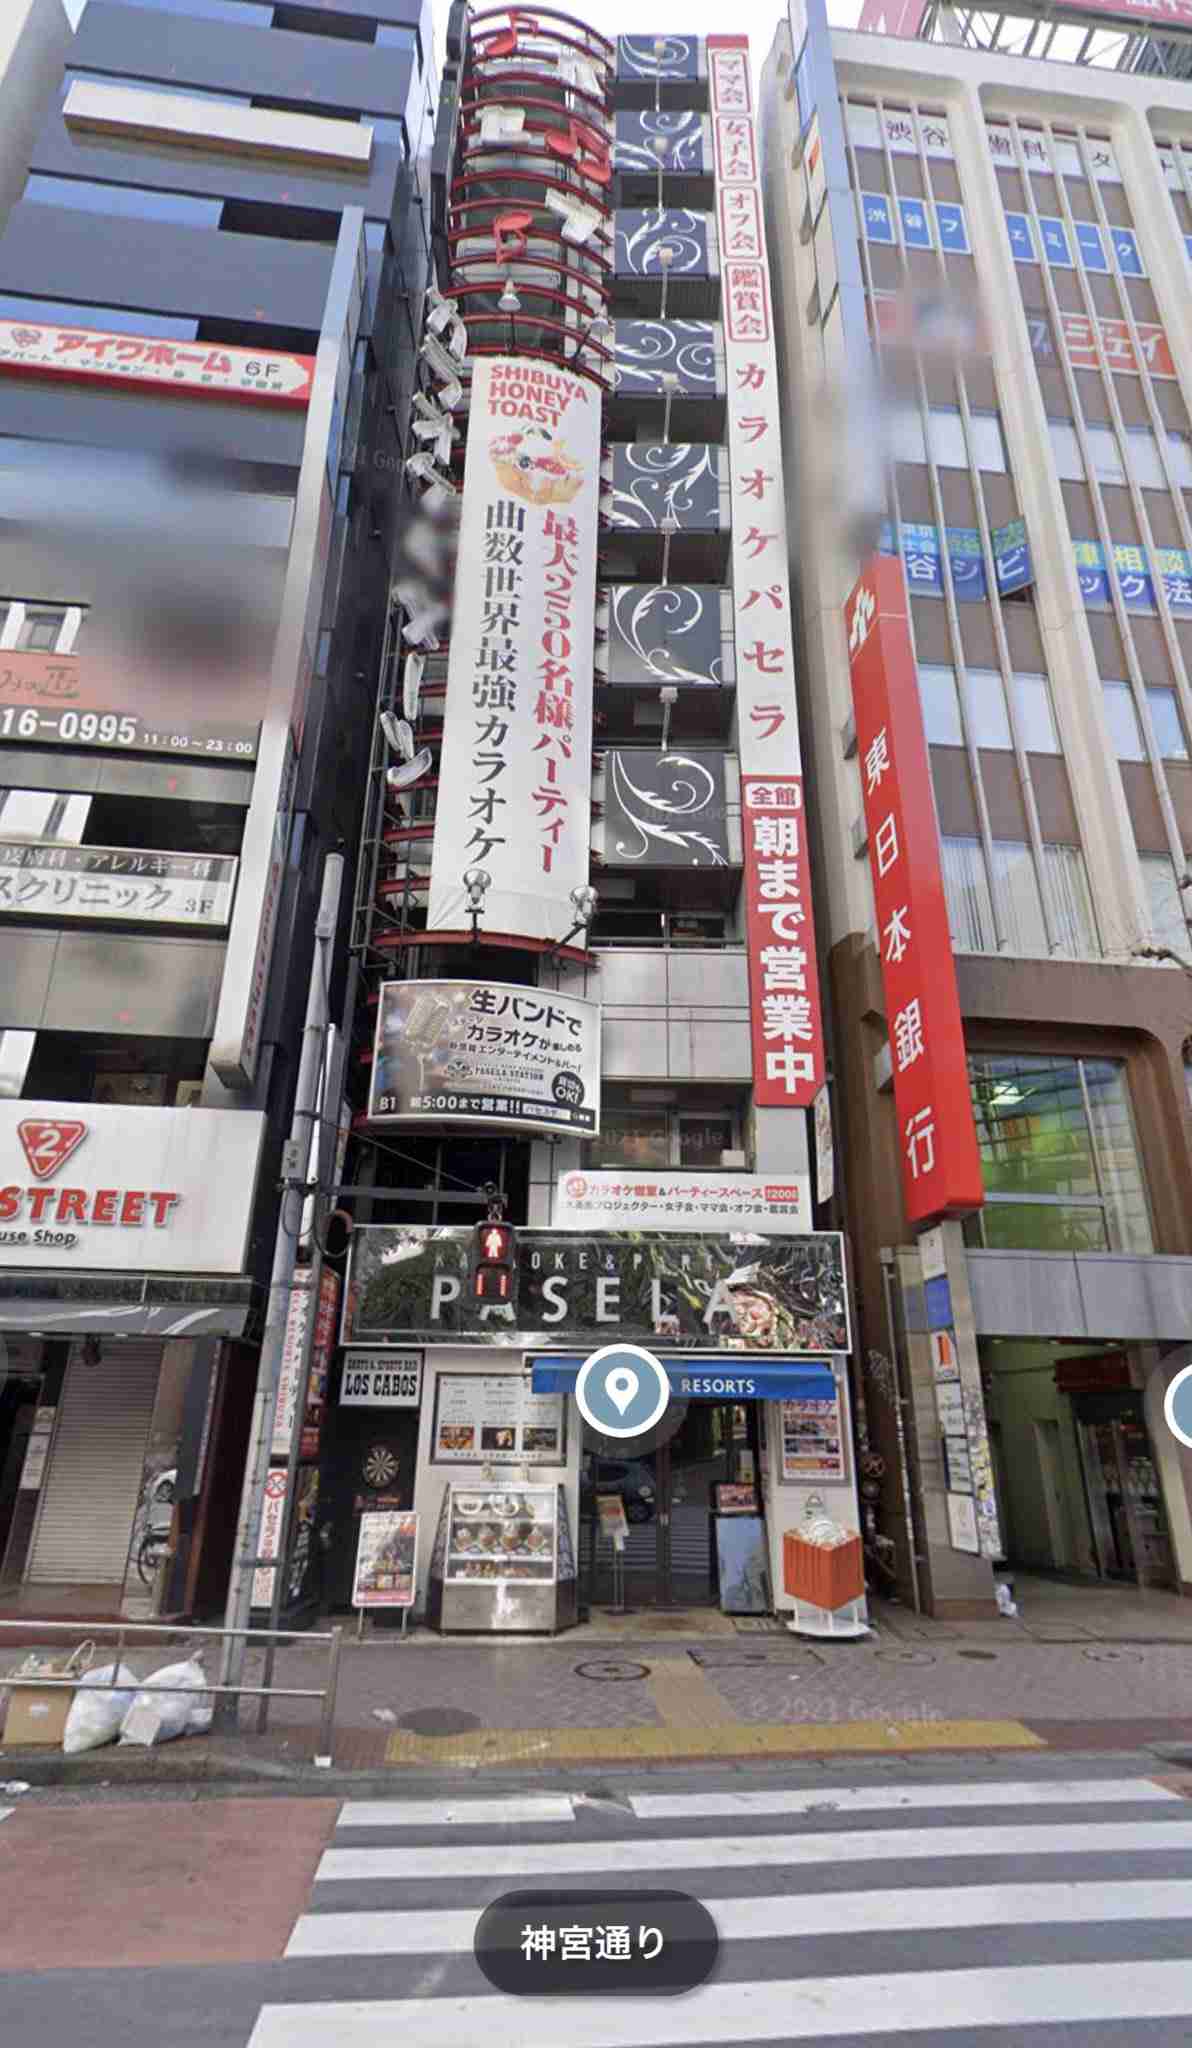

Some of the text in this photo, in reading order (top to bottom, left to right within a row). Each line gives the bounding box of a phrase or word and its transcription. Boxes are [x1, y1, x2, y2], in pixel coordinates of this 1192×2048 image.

[725, 120, 750, 176] 女子会
[730, 190, 752, 249] オフ会
[731, 267, 762, 335] 鑑賞会
[54, 332, 232, 373] アイワホーム
[244, 360, 281, 377] 6F
[490, 381, 571, 412] HONEY
[491, 365, 589, 404] SHIBUYA
[488, 400, 561, 427] TOAST
[736, 362, 786, 740] カラオケパセラ
[464, 500, 527, 864] 曲数世界最強カラオケ
[531, 510, 578, 873] 最大250名様パーティー
[1, 708, 137, 744] 16-0995
[751, 786, 797, 806] 全館
[185, 899, 213, 913] 3F
[752, 815, 816, 1095] 朝まで営業中
[865, 727, 936, 1180] 東日本銀行
[469, 990, 583, 1036] 生バンドで
[33, 1129, 62, 1157] 2
[0, 1186, 179, 1227] STREET
[34, 1229, 76, 1245] Shop
[345, 1375, 417, 1396] LOS CABOS
[681, 1379, 755, 1393] RESORTS
